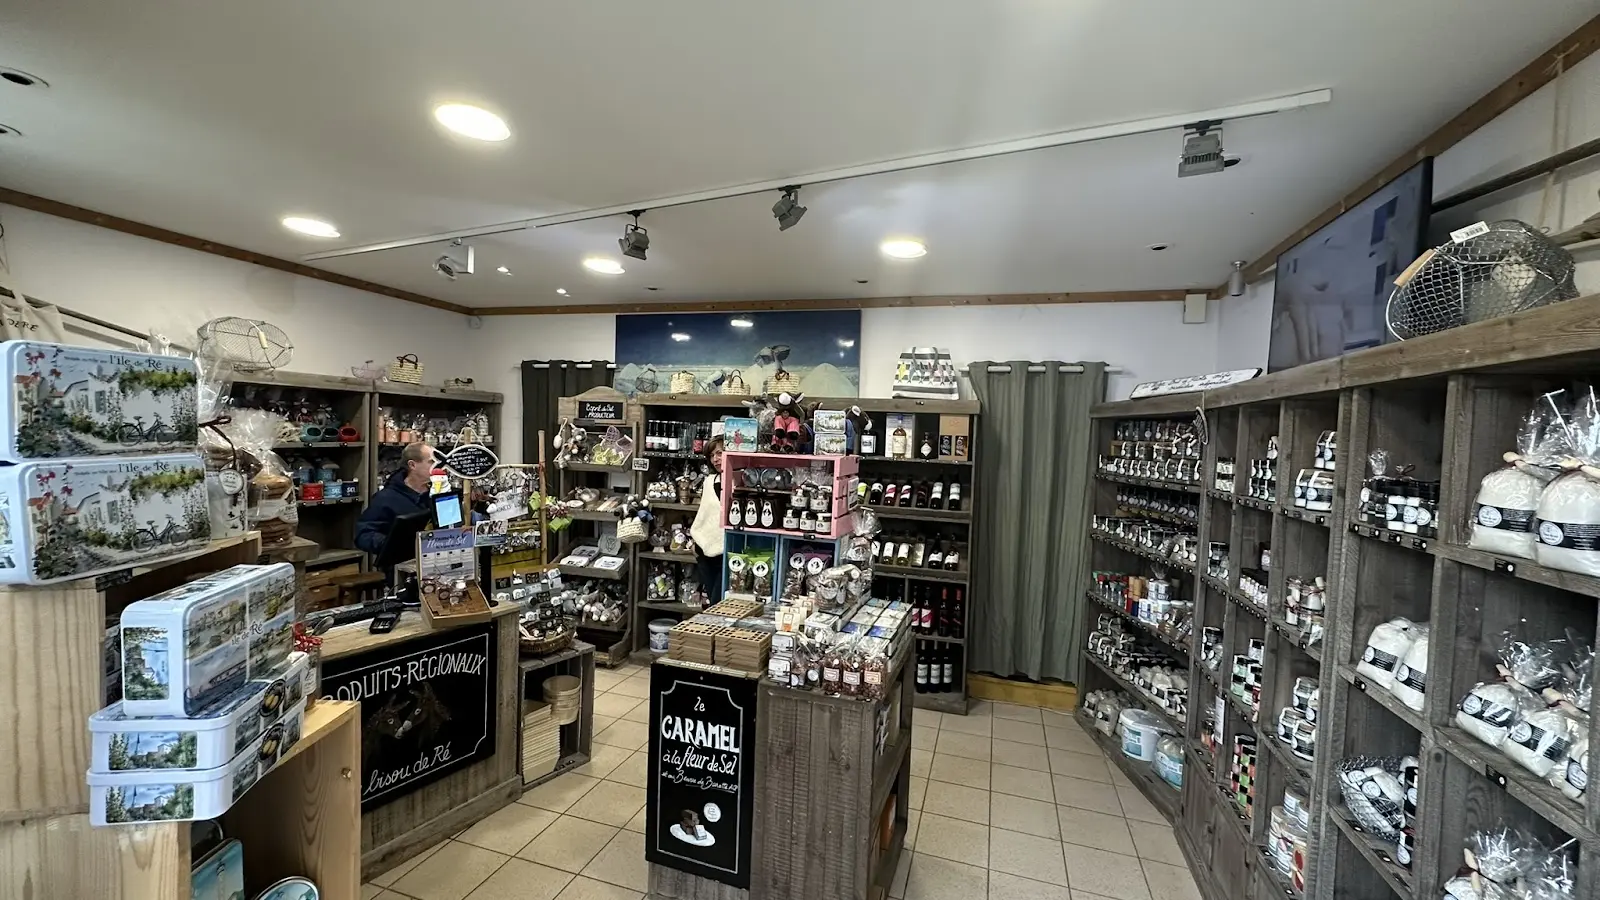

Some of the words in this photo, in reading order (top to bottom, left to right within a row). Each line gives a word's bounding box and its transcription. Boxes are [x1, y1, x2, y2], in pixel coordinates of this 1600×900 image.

[146, 357, 164, 371] Ré
[154, 460, 171, 473] Ré
[250, 620, 264, 636] Ré
[321, 652, 486, 701] ODUITS-RÉGIONAUX
[693, 696, 706, 712] le
[661, 714, 740, 754] CARAMEL
[662, 748, 671, 763] à
[670, 749, 681, 765] la
[675, 745, 710, 771] fleur
[706, 753, 719, 773] de
[718, 753, 738, 776] Sel
[363, 769, 412, 796] bisou
[413, 751, 430, 773] de
[430, 740, 452, 767] Ré
